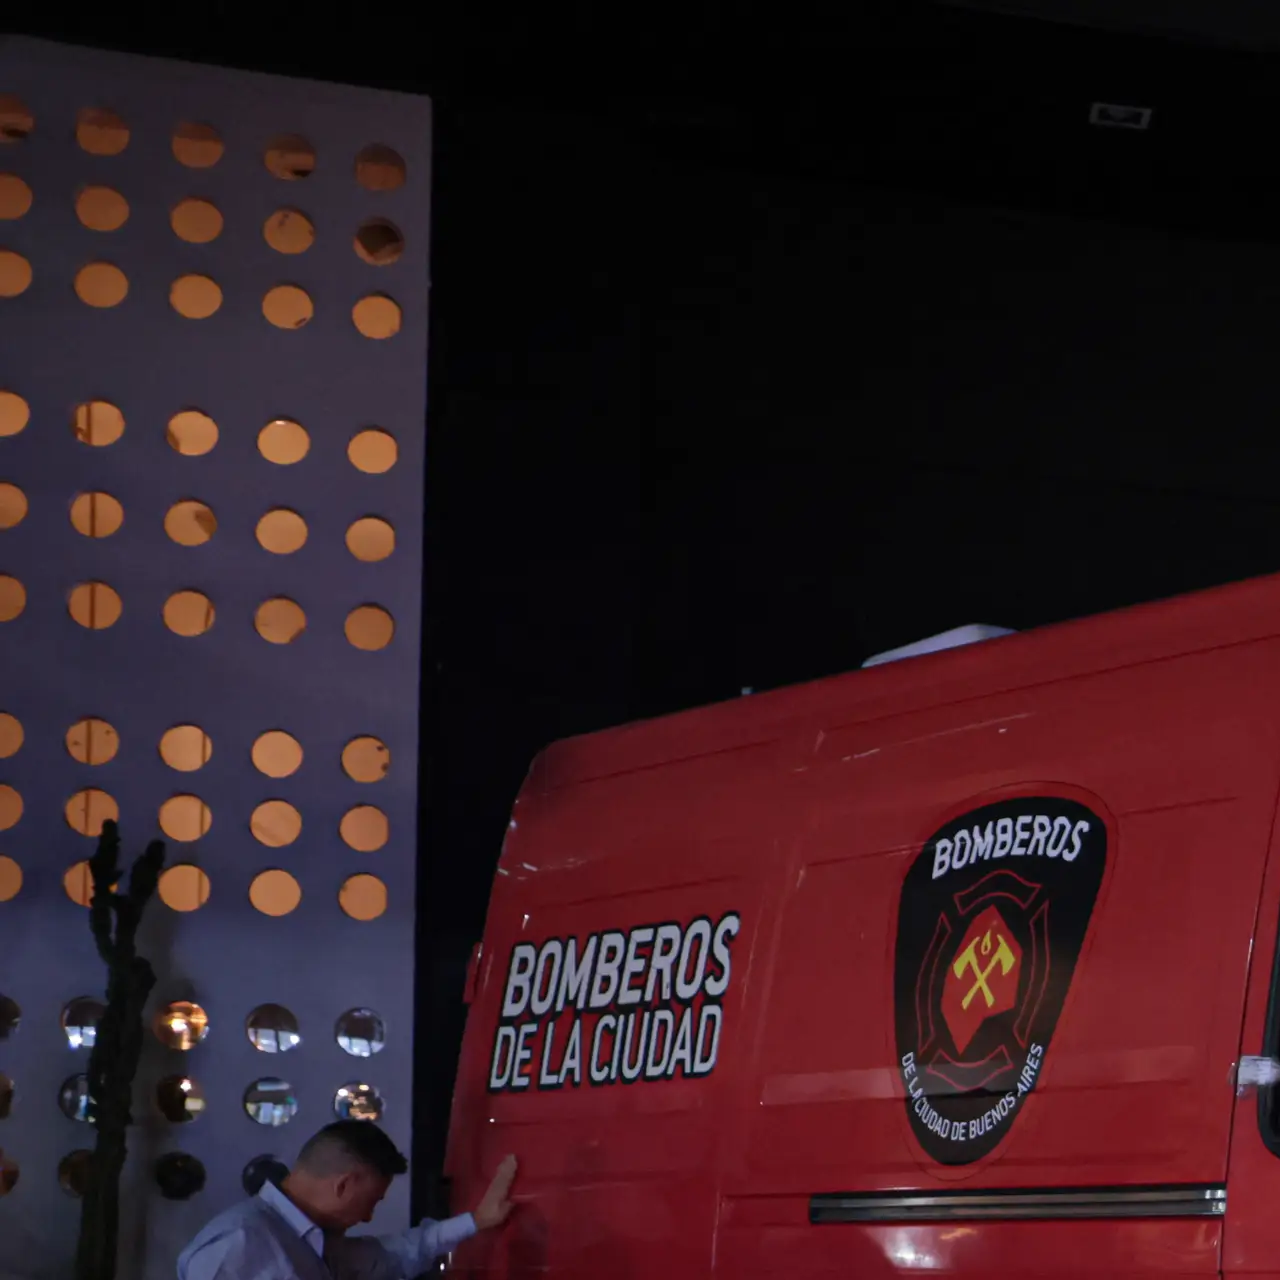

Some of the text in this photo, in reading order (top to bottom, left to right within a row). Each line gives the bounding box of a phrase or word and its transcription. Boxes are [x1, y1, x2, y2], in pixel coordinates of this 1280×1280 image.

[932, 815, 1090, 880] BOMBEROS
[502, 914, 741, 1018] BOMBEROS
[489, 1004, 723, 1089] DE LA CIUDAD
[901, 1043, 1044, 1141] DE LA CIUDAD DE BUENOS AIRES
